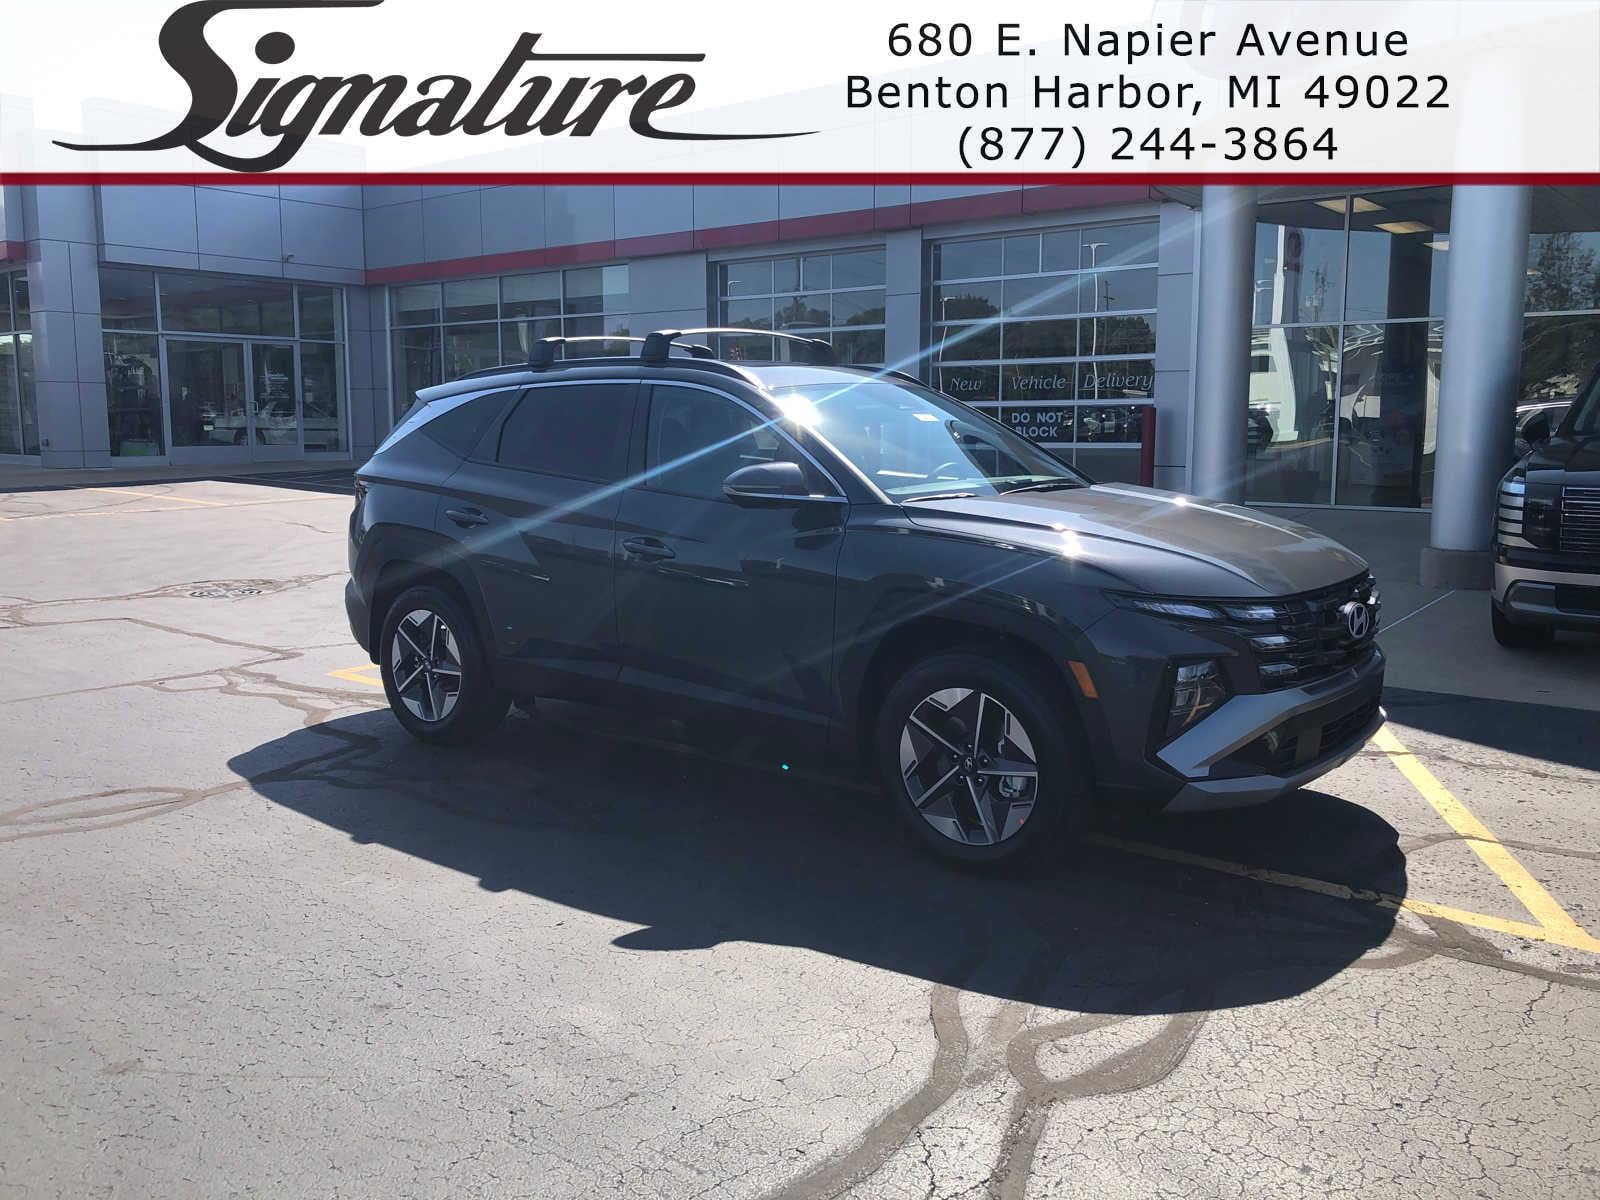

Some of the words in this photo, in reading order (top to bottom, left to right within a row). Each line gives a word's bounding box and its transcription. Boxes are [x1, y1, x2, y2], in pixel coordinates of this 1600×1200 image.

[950, 377, 982, 391] New
[1011, 375, 1066, 390] Vehicle
[1083, 372, 1154, 390] Delivery
[1011, 412, 1030, 423] DO
[1036, 412, 1063, 423] NOT
